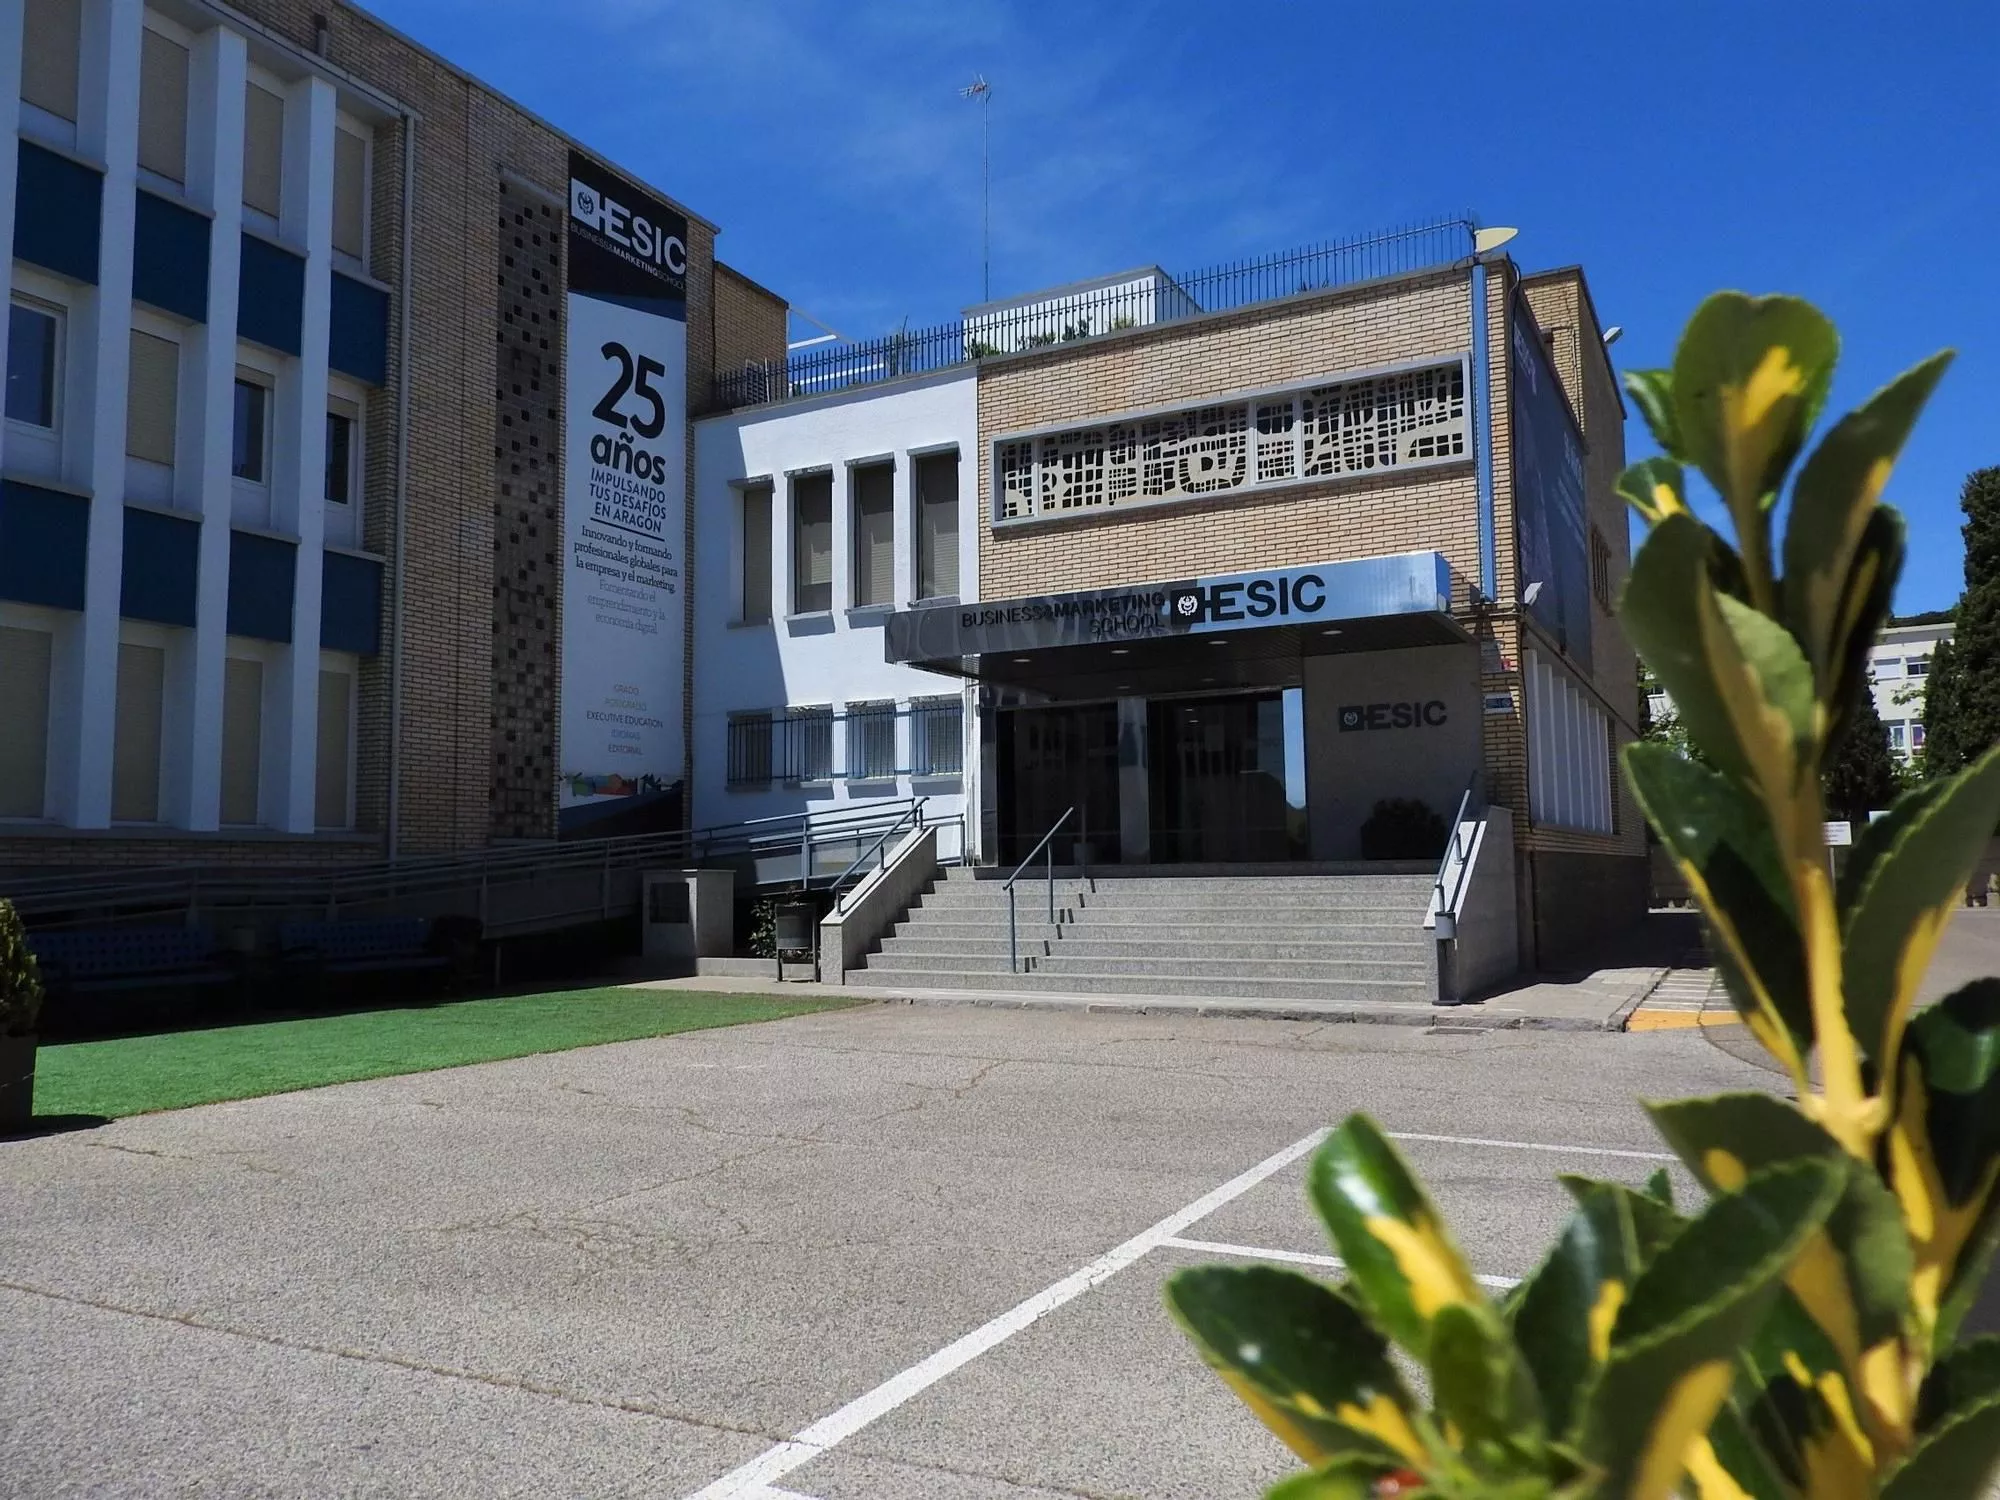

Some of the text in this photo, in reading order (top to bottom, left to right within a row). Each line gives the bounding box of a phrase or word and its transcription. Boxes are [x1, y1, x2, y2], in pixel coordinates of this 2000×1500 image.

[604, 197, 686, 275] ESIC
[592, 341, 665, 439] 25
[590, 432, 666, 485] años
[590, 483, 610, 501] TUS
[591, 467, 665, 503] IMPULSANDO
[595, 502, 611, 517] EN
[574, 542, 678, 577] profesionales globales para
[582, 525, 627, 547] Innovando
[635, 540, 672, 560] formando
[576, 555, 584, 568] la
[585, 561, 620, 578] empresa
[628, 570, 635, 581] el
[1211, 575, 1325, 621] ESIC
[1090, 612, 1165, 635] SCHOOL
[586, 710, 663, 728] EXECUTIVE EDUCATION
[1368, 700, 1448, 730] ESIC
